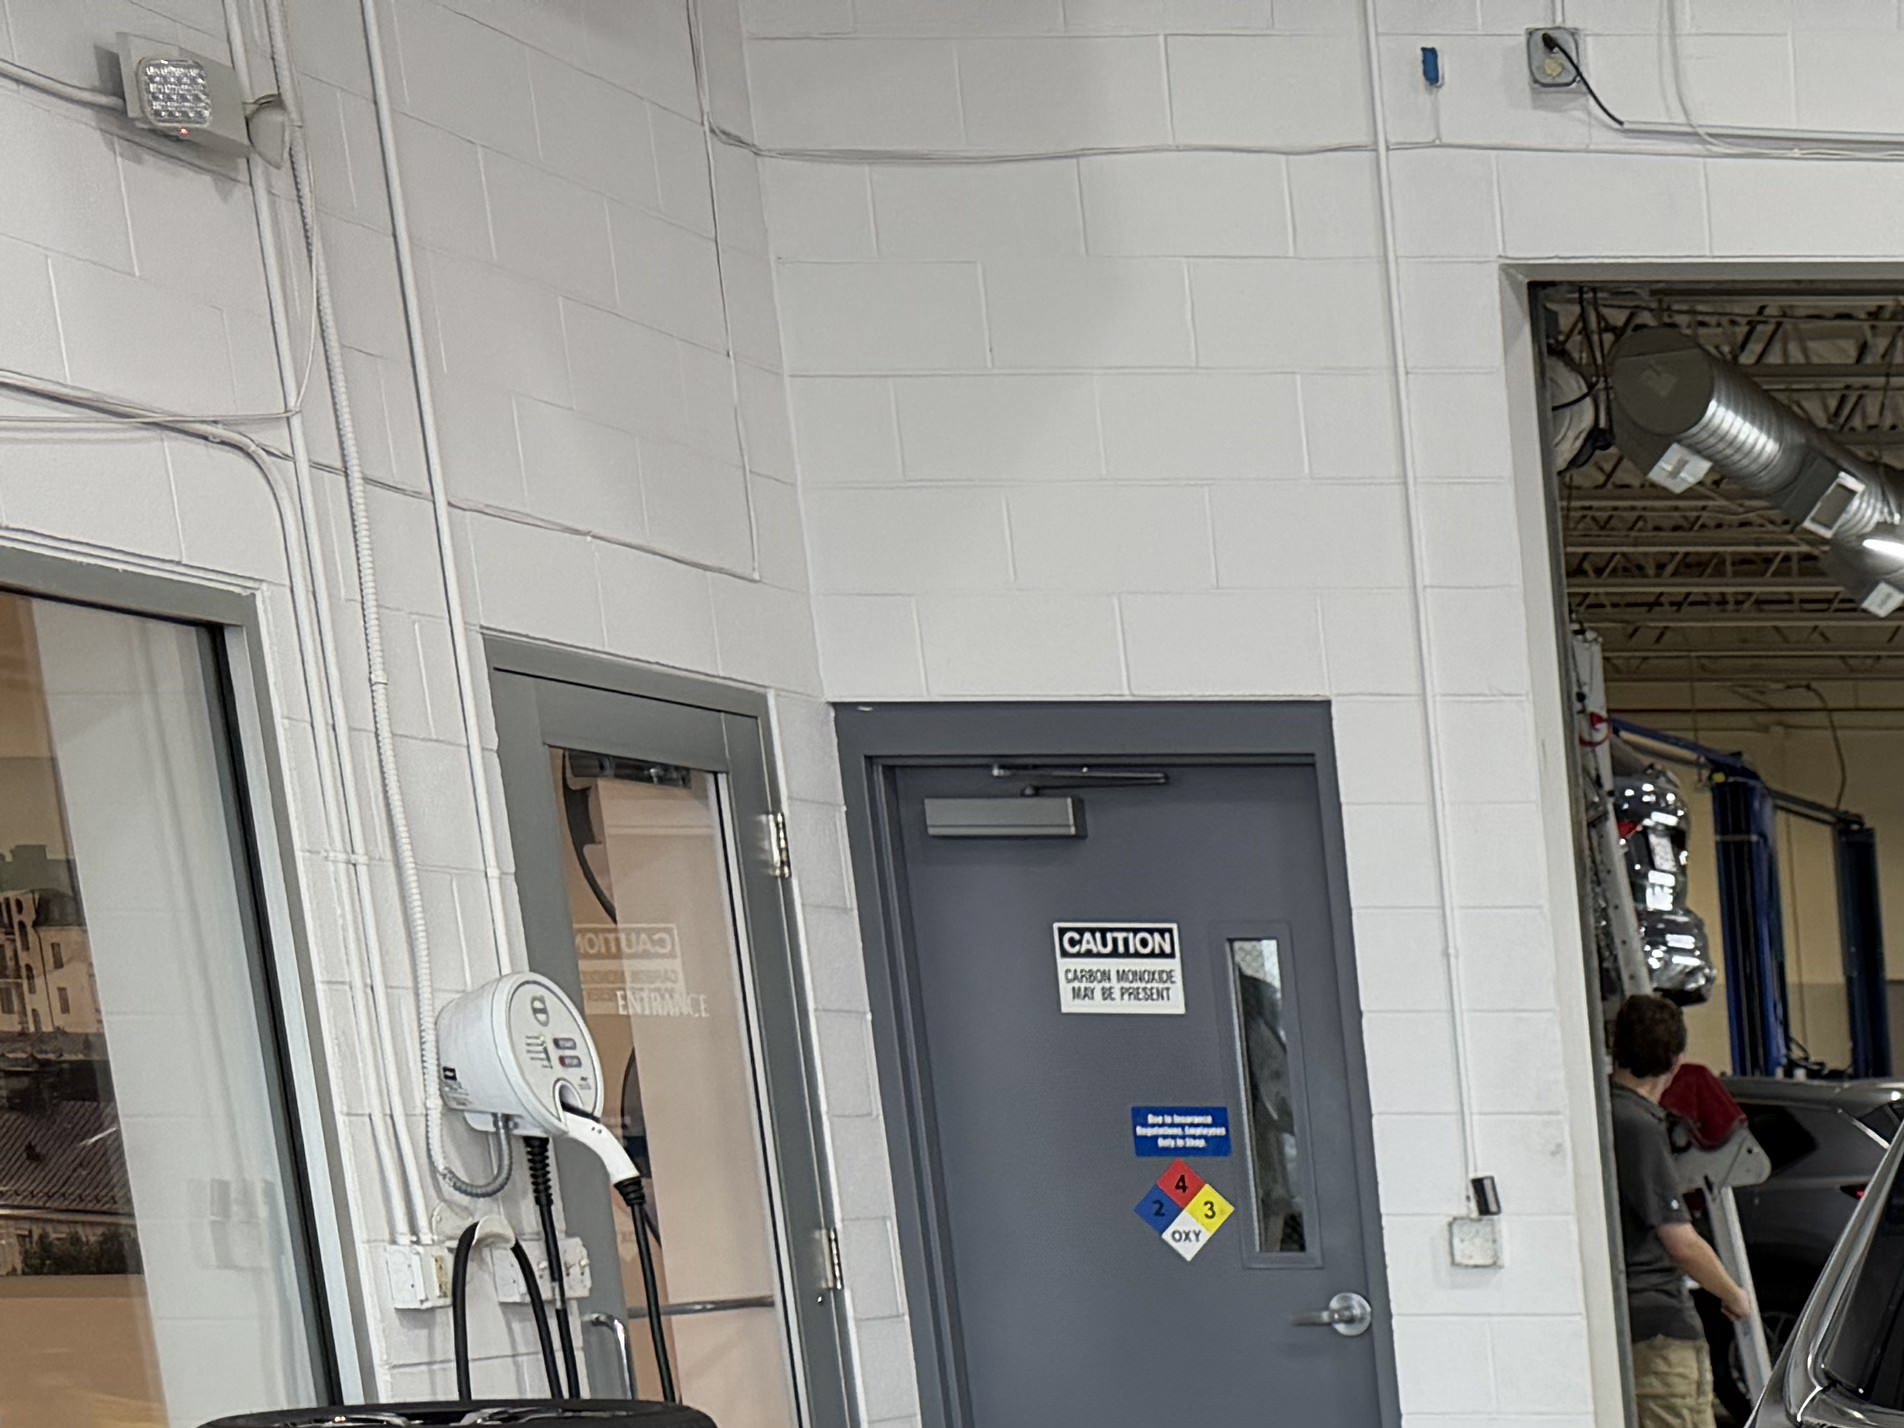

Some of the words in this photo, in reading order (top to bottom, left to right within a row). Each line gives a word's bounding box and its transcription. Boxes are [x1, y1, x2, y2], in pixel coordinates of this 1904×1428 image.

[1062, 931, 1172, 954] CAUTION
[1064, 968, 1112, 984] CARBON
[1116, 968, 1177, 984] MONOXIDE
[1071, 986, 1096, 1000] MAY
[1100, 986, 1116, 1000] BE
[1120, 986, 1171, 1001] PRESENT
[616, 990, 710, 1018] ENTRANCE
[1174, 1174, 1188, 1193] 4
[1152, 1201, 1165, 1217] 2
[1203, 1201, 1216, 1219] 3
[1171, 1230, 1202, 1242] OXY
